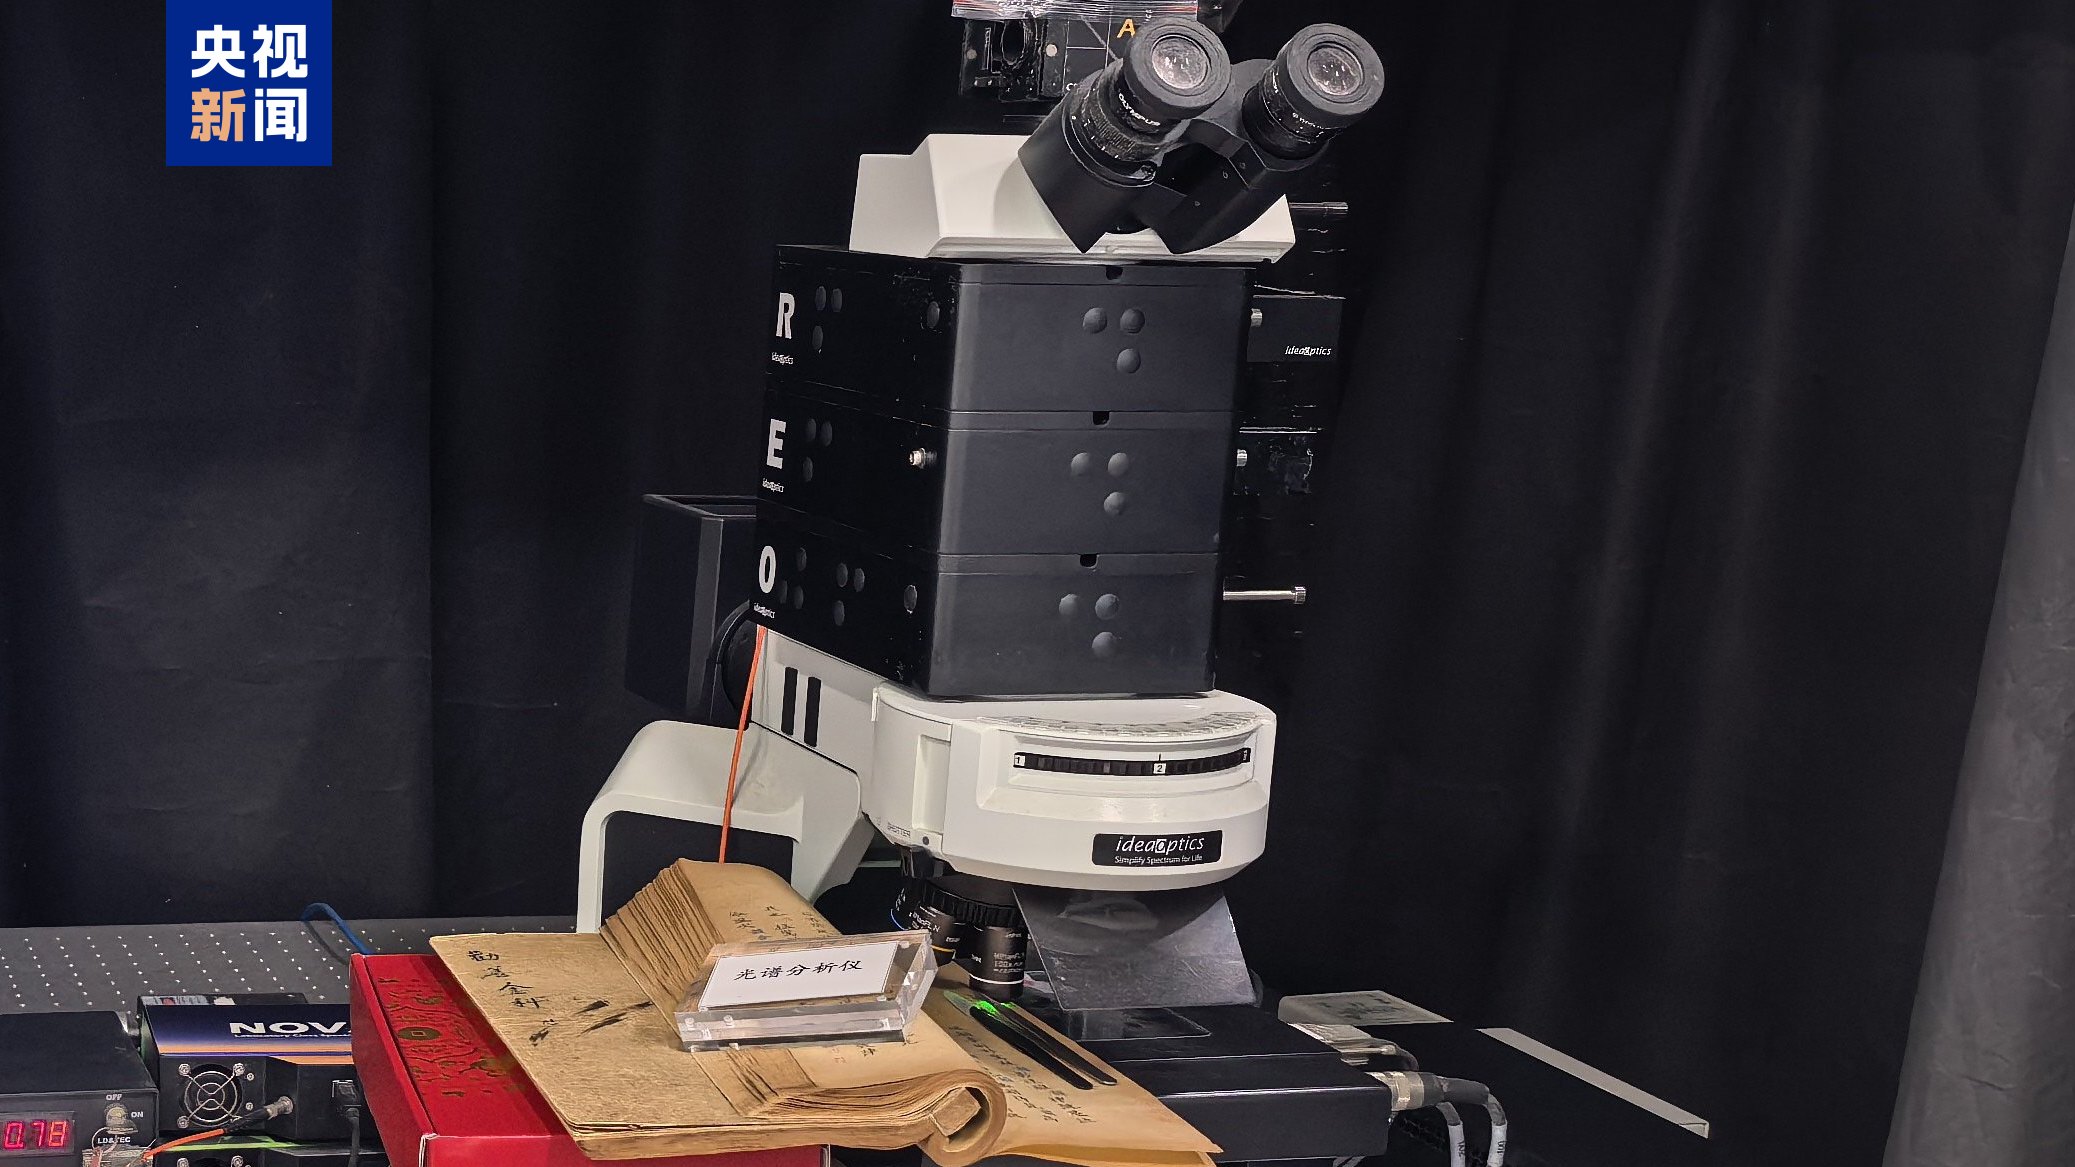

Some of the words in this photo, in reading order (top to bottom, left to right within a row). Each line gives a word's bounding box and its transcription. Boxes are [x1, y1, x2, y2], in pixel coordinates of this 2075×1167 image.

[1117, 19, 1136, 38] A
[775, 292, 796, 340] R
[766, 418, 787, 470] E
[758, 545, 777, 594] O
[1114, 855, 1146, 866] Simplify
[1146, 856, 1181, 865] Spectrum
[1181, 854, 1191, 863] for
[1191, 853, 1203, 862] Life
[733, 960, 863, 980] 光谱分析仪
[229, 1021, 352, 1034] NOV
